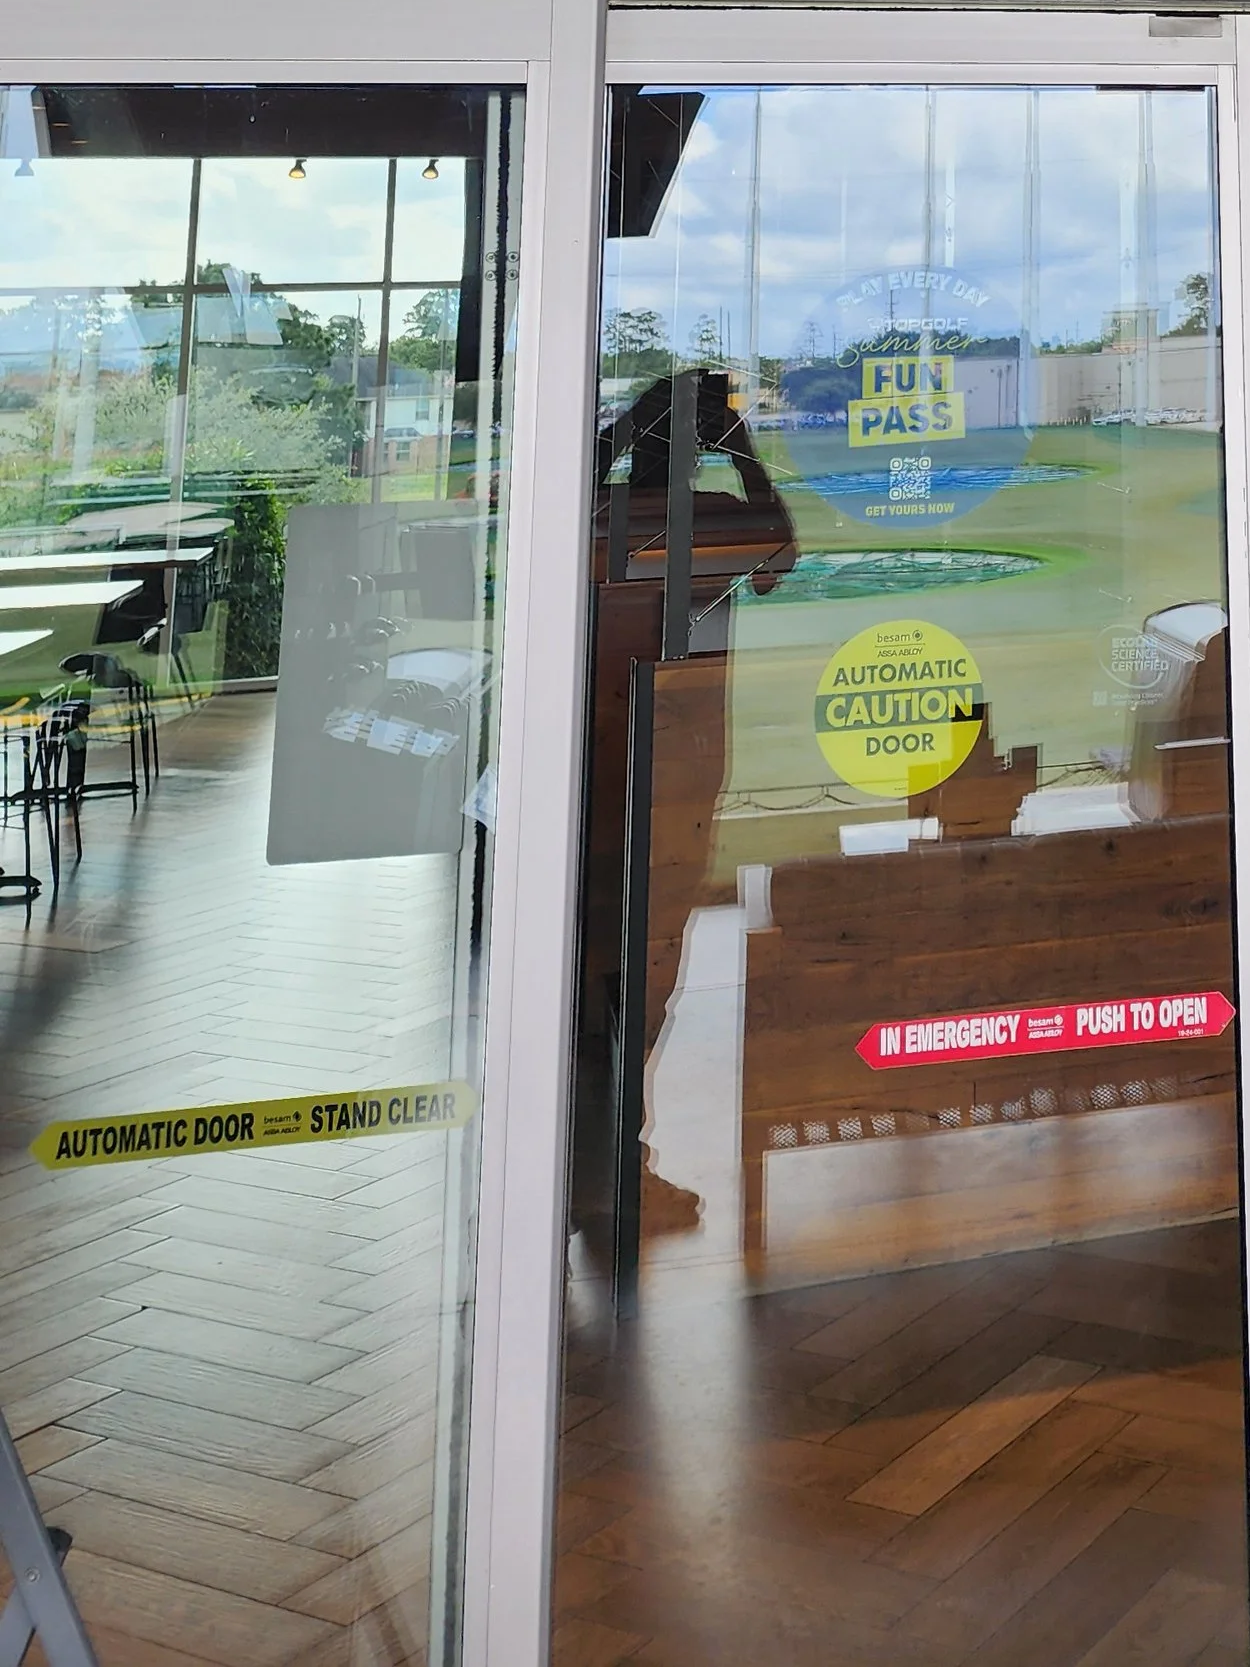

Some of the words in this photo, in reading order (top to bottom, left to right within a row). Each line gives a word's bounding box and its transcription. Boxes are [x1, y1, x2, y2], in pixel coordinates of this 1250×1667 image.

[836, 276, 884, 312] PLAY
[887, 270, 952, 291] EVERY
[952, 279, 992, 308] DAY
[885, 317, 969, 332] TOPGOLF
[836, 334, 988, 368] Summer
[873, 362, 943, 393] FUN
[861, 401, 953, 437] PASS
[865, 505, 886, 517] GET
[889, 503, 925, 516] YOURS
[928, 502, 955, 514] NOW
[877, 633, 911, 643] besam
[877, 649, 898, 658] ASSA
[898, 647, 923, 656] ABLOY
[1111, 648, 1158, 660] SCIENCE
[1111, 660, 1169, 672] CERTIFIED
[832, 658, 967, 687] AUTOMATIC
[825, 687, 974, 728] CAUTION
[866, 732, 935, 756] DOOR
[1028, 1018, 1054, 1028] besam
[1076, 1003, 1125, 1036] PUSH
[1130, 1002, 1155, 1031] TO
[1159, 996, 1207, 1028] OPEN
[880, 1026, 900, 1056] IN
[905, 1014, 1021, 1054] EMERGENCY
[263, 1114, 291, 1124] besam
[310, 1099, 381, 1134] STAND
[388, 1092, 456, 1125] CLEAR
[55, 1119, 188, 1160] AUTOMATIC
[193, 1112, 254, 1145] DOOR
